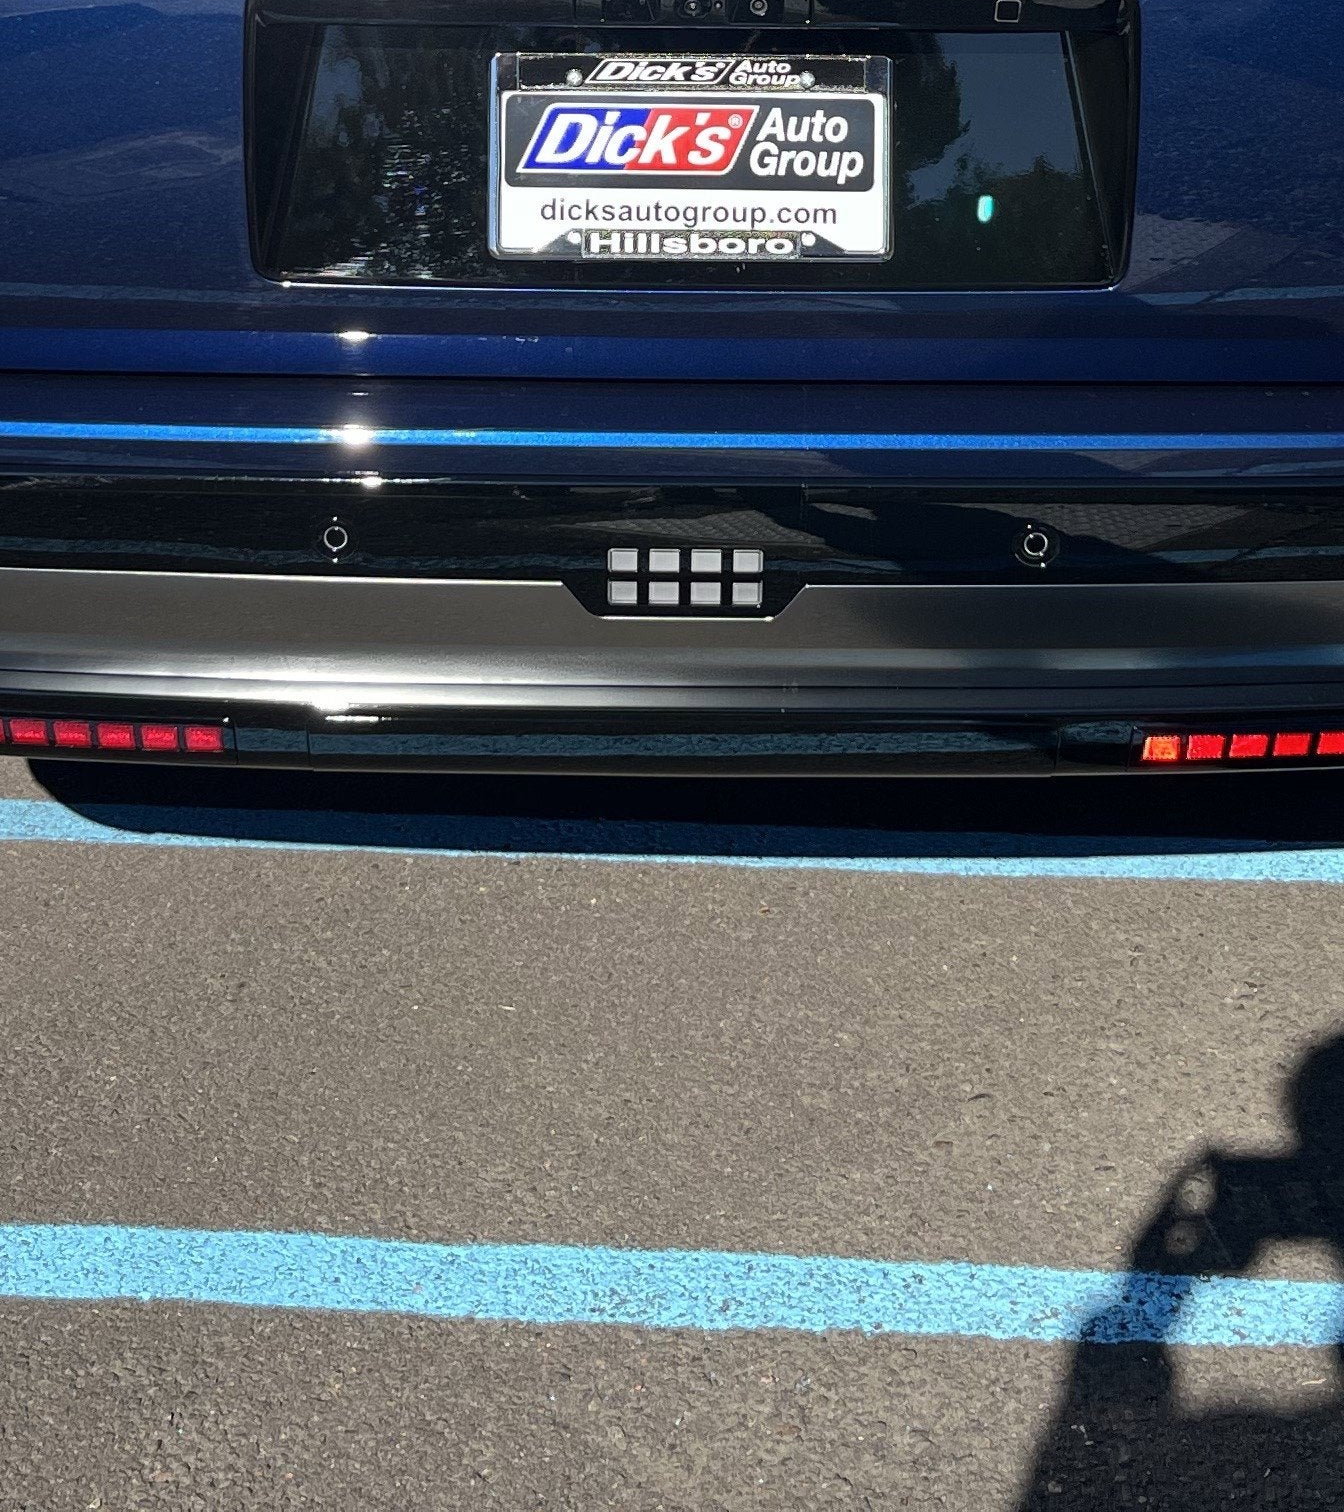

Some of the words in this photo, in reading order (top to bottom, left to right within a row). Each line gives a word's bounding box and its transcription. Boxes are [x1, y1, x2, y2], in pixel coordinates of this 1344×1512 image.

[734, 59, 792, 73] Auto
[729, 72, 800, 87] Group
[755, 107, 849, 143] Auto
[749, 143, 864, 185] Group
[540, 197, 838, 227] dicksautogroup.com
[589, 232, 795, 255] Hillsboro
